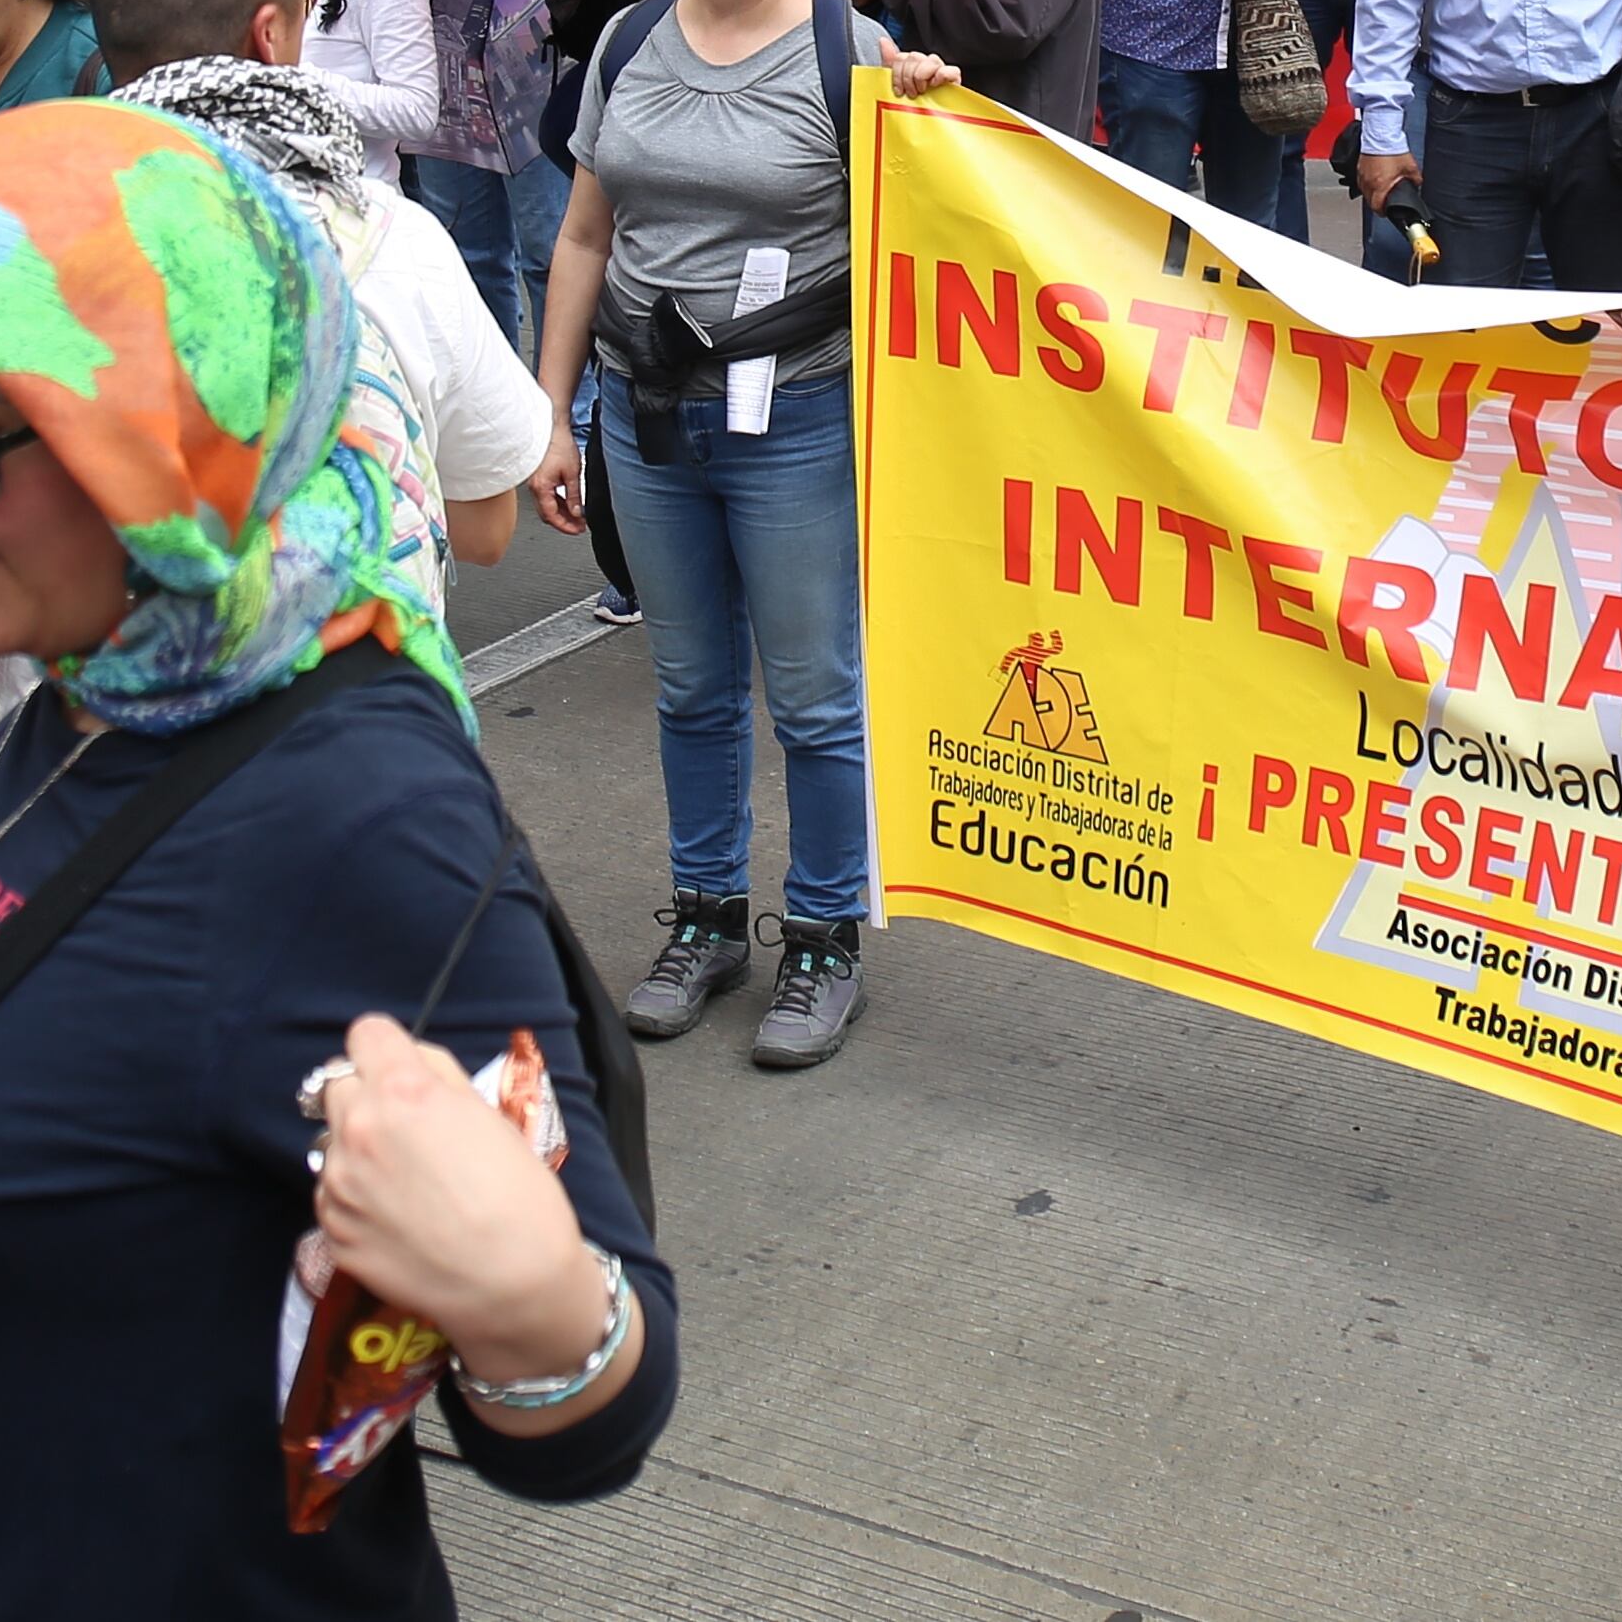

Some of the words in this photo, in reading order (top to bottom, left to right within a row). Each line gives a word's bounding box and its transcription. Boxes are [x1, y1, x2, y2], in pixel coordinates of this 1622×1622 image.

[929, 728, 1046, 783] Asociación
[1052, 758, 1141, 807] Distrital
[1147, 782, 1174, 815] de
[929, 765, 1024, 812] Trabajadores
[1025, 794, 1037, 821] y
[1039, 792, 1133, 841] Trabajadoras
[1137, 819, 1156, 847] de
[1158, 823, 1173, 851] la
[930, 798, 1169, 908] Educación
[1386, 909, 1574, 992] Asociación
